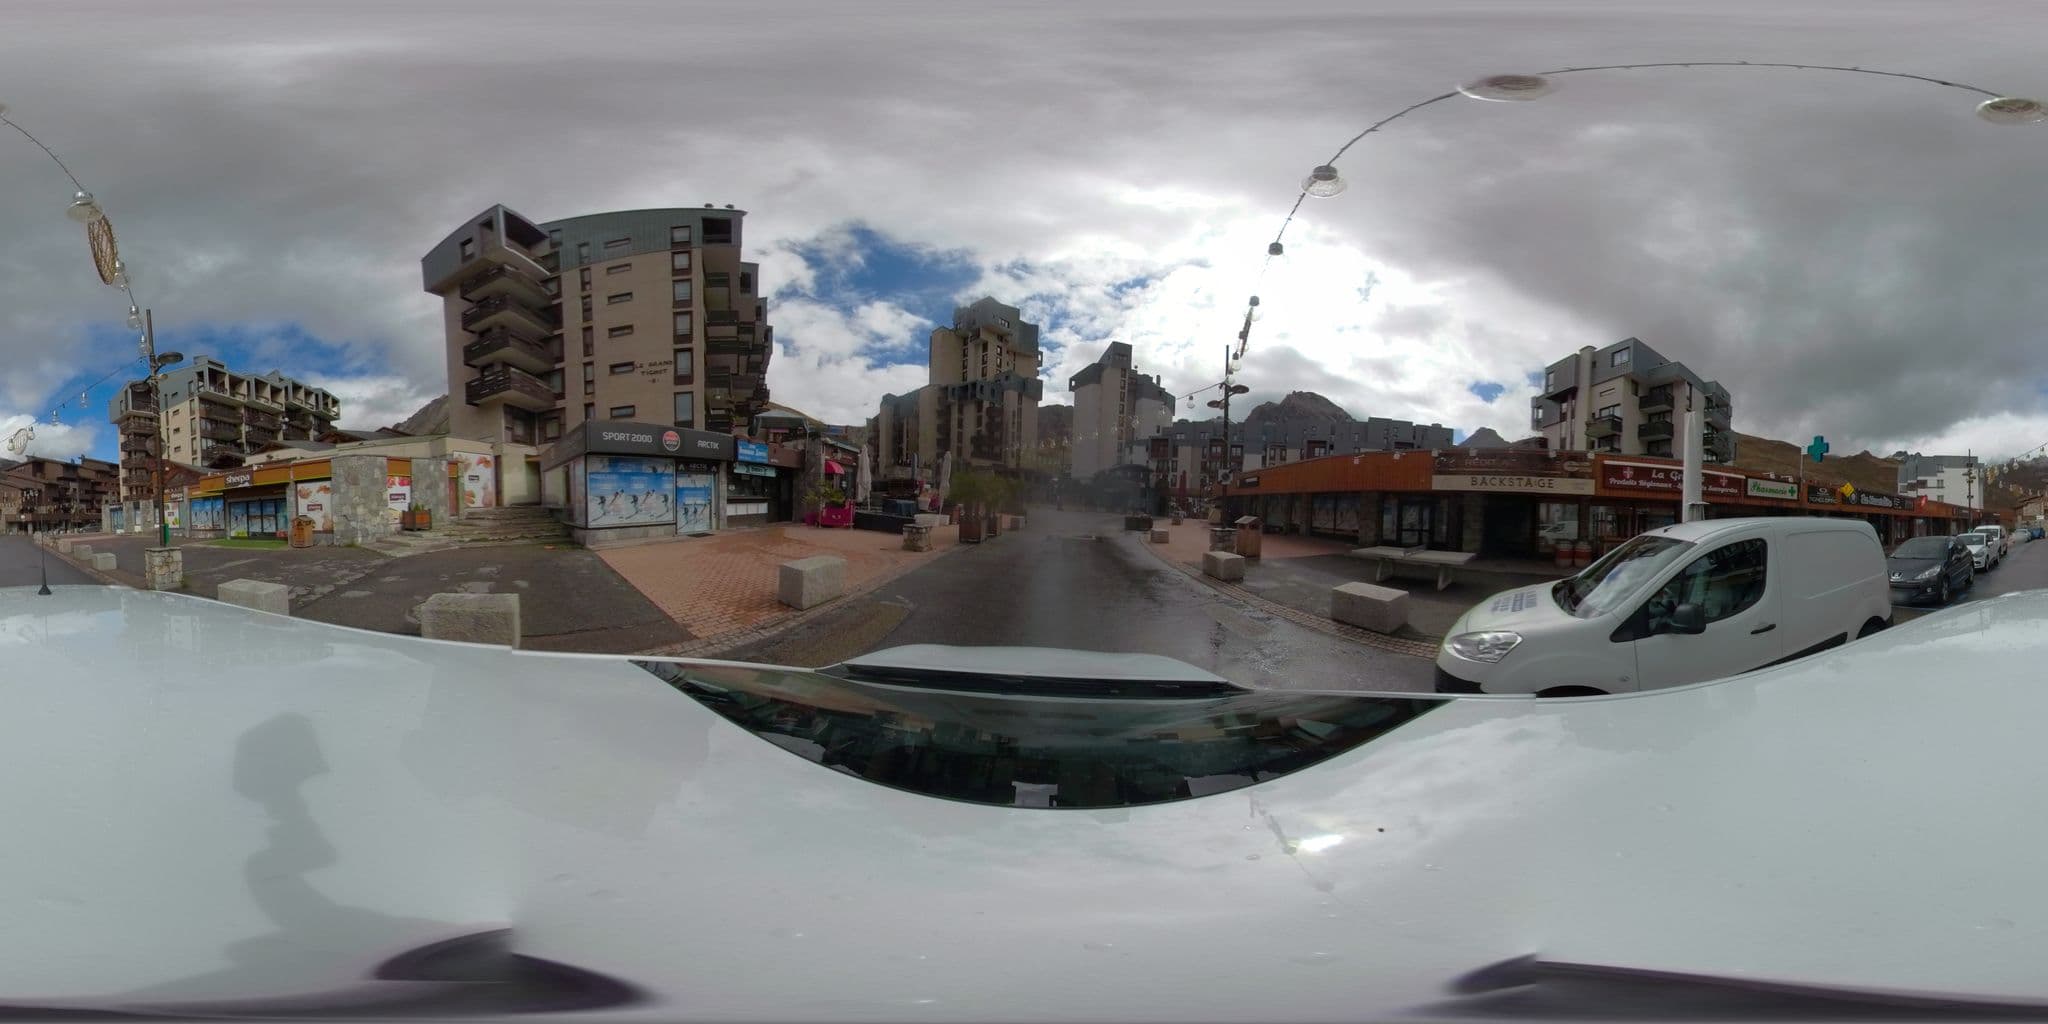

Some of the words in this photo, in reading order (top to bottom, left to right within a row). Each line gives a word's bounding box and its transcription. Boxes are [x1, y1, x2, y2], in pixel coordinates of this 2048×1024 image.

[602, 431, 630, 441] SPORT
[631, 433, 653, 443] 2000
[226, 473, 250, 484] sherpa
[1651, 469, 1665, 479] La
[1470, 476, 1555, 489] BACKSTAGE
